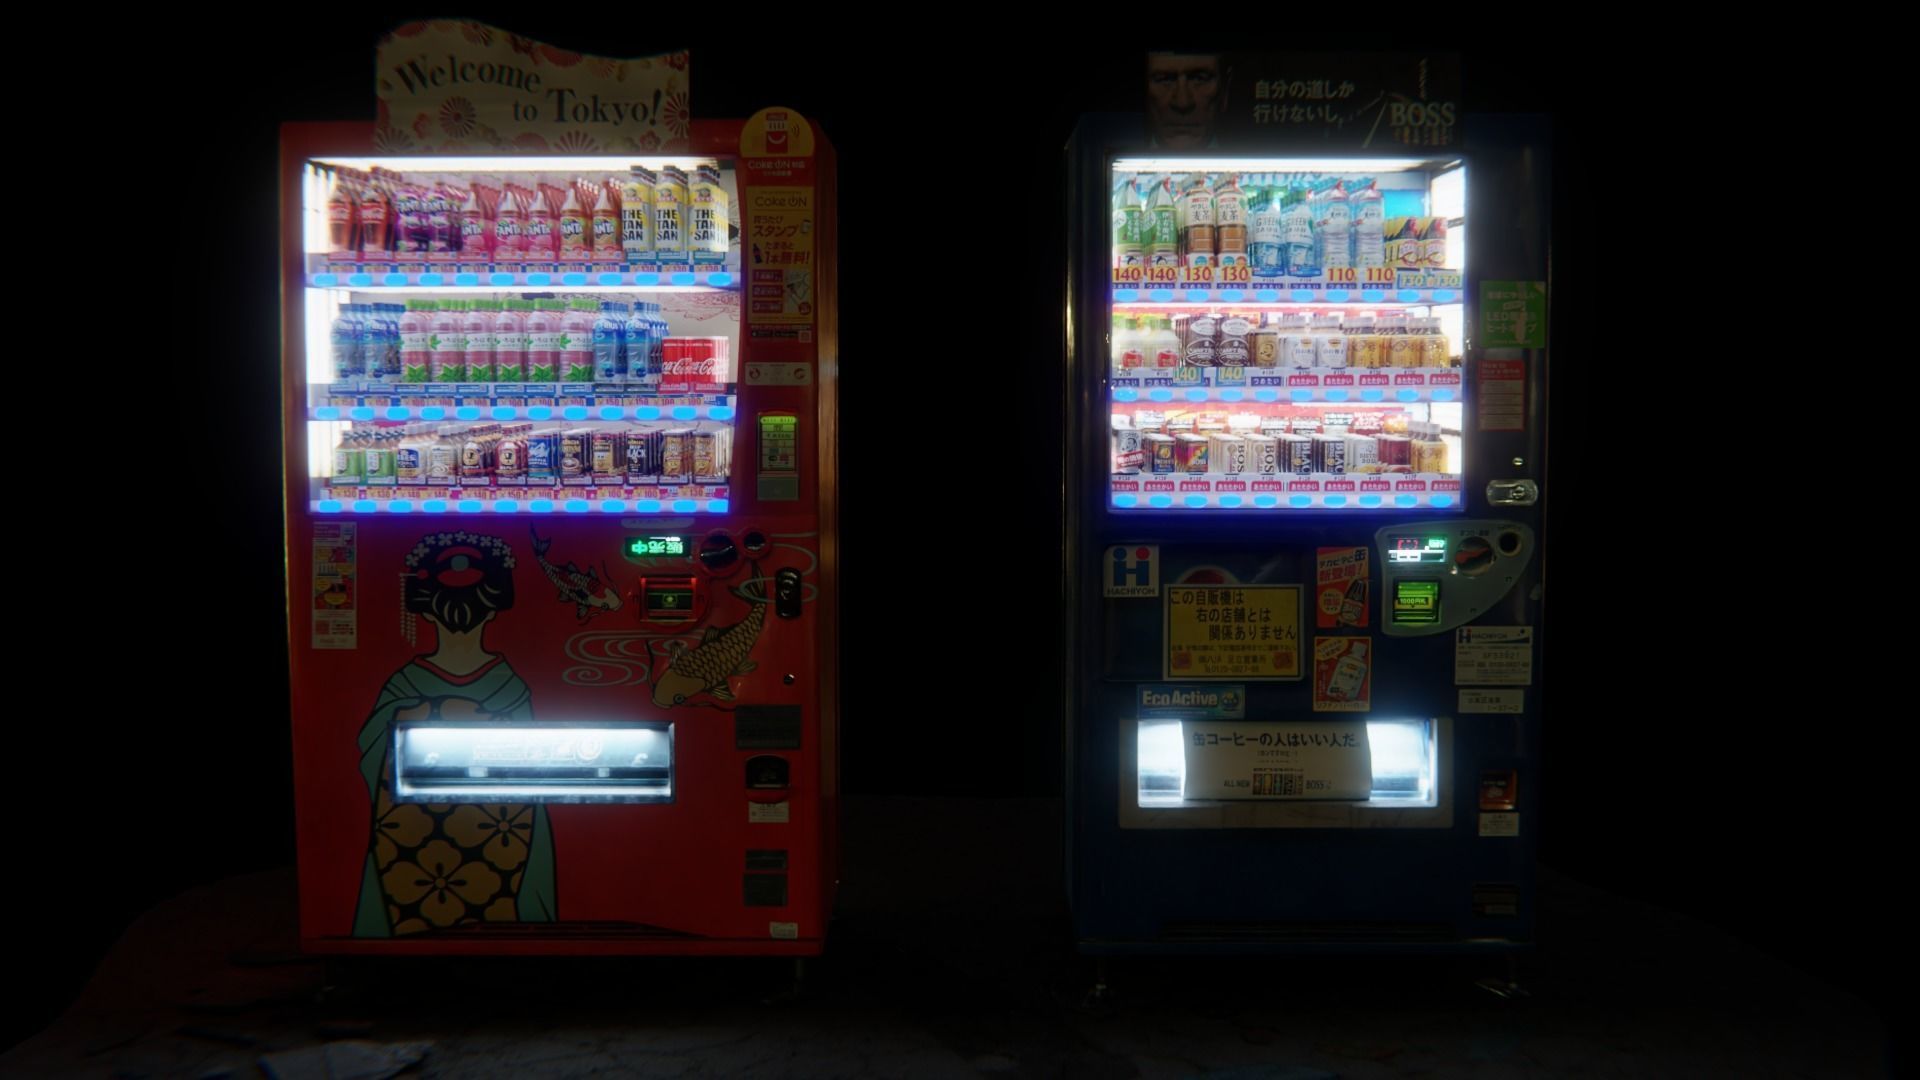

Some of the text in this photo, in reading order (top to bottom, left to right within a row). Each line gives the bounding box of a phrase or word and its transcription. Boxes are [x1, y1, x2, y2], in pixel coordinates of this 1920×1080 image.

[395, 55, 541, 95] Welcome
[1254, 80, 1355, 100] 自分の道しか
[513, 87, 662, 126] to Tokyo!
[1388, 101, 1456, 128] BOSS
[754, 196, 786, 207] Coke
[623, 210, 643, 219] THE
[657, 210, 678, 219] THE
[696, 210, 716, 219] THE
[1192, 210, 1210, 221] 麦茶
[1222, 210, 1238, 220] 麦茶
[623, 220, 644, 230] TAN
[657, 220, 678, 230] TAN
[695, 220, 716, 230] TAN
[753, 224, 799, 238] スタンプ
[622, 230, 644, 240] SAN
[656, 230, 678, 240] SAN
[694, 230, 716, 240] SAN
[1114, 268, 1141, 280] 140
[1150, 268, 1175, 280] 140
[1186, 267, 1212, 280] 130
[1222, 267, 1248, 280] 130
[1328, 268, 1354, 281] 110
[1366, 268, 1394, 281] 110
[1220, 367, 1242, 380] 140
[1302, 442, 1312, 472] BLAC
[1334, 442, 1345, 472] BLAC
[1107, 587, 1155, 596] HACHIYOH
[1170, 590, 1244, 606] この自販機は
[1196, 608, 1272, 622] 右の店舗とは
[1208, 625, 1296, 640] 関係ありません
